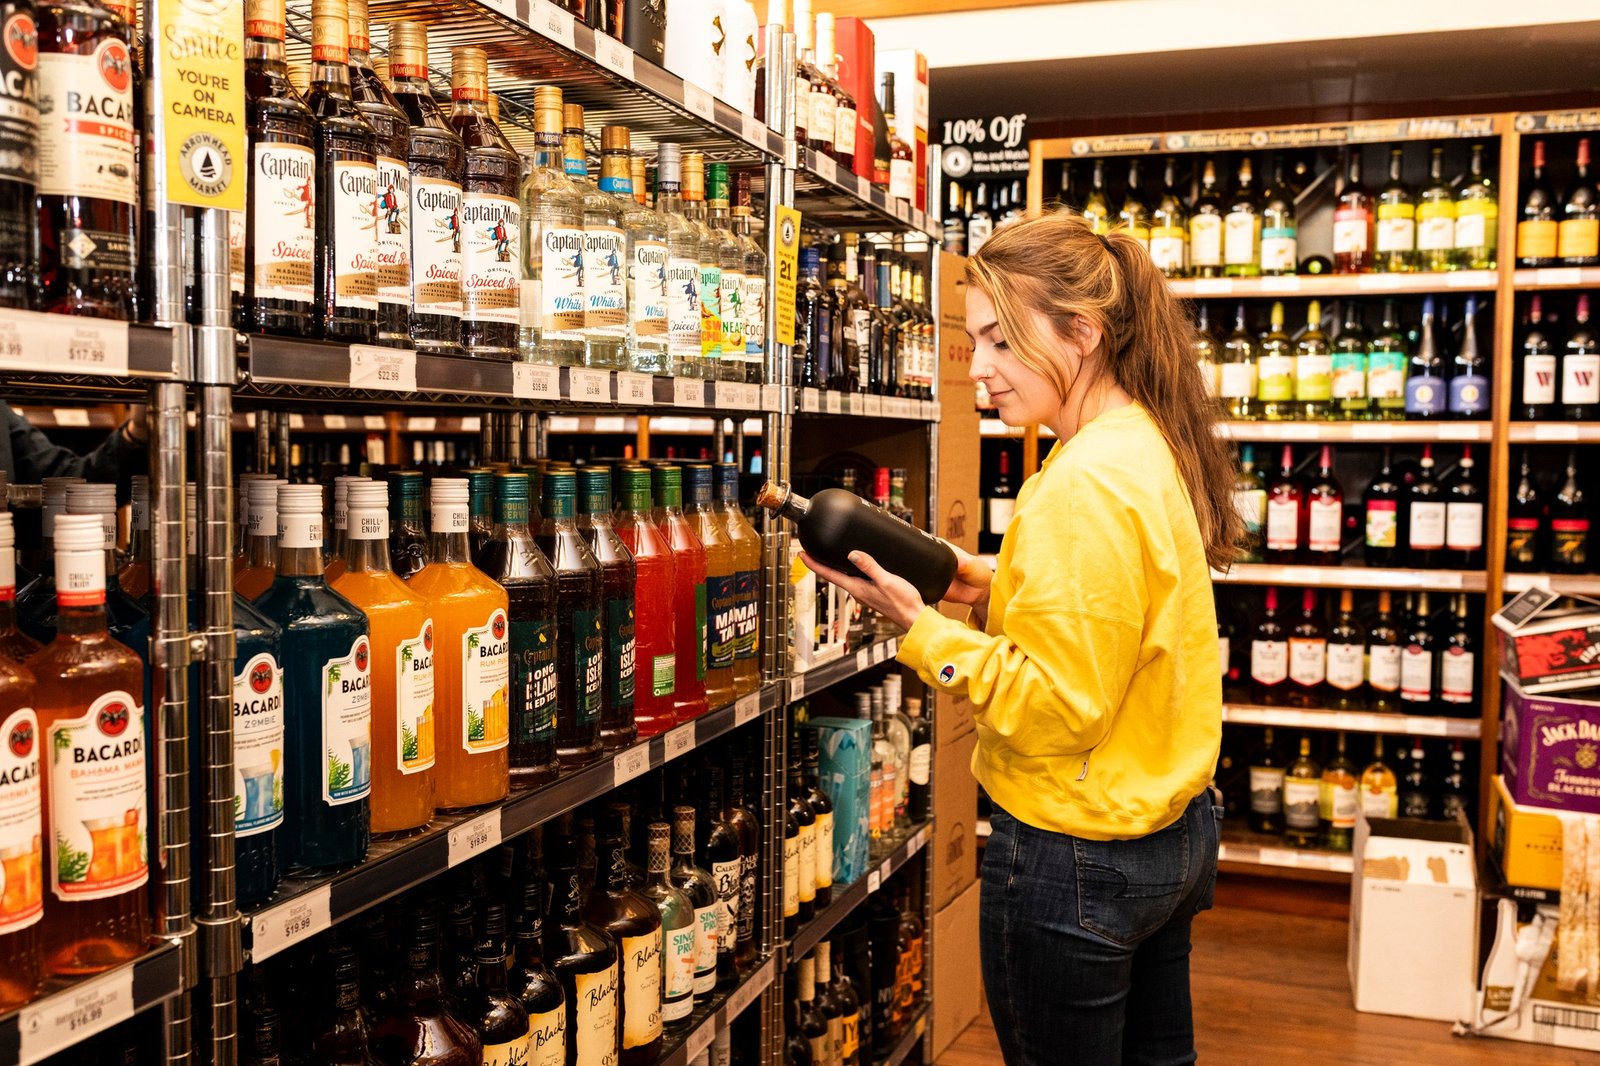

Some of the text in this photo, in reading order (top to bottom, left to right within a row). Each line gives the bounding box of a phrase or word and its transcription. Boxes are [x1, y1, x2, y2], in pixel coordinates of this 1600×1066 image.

[165, 24, 239, 61] Smile
[177, 68, 230, 91] YOU'RE
[193, 89, 215, 104] ON
[172, 102, 236, 125] CAMERA
[943, 113, 1027, 148] 10% Off
[180, 134, 232, 166] ARROWHEAD
[260, 153, 308, 179] Captain
[190, 177, 227, 195] MARKET
[416, 187, 457, 211] Captain
[546, 232, 580, 252] Captain
[425, 264, 459, 280] Spiced
[780, 260, 791, 281] 21
[466, 273, 506, 289] Spiced
[555, 297, 581, 310] White
[590, 295, 616, 308] White
[69, 348, 105, 362] $17.99
[378, 371, 399, 381] $22.99
[361, 518, 380, 526] CHILL
[69, 581, 90, 589] ENJOY
[735, 601, 757, 622] MAI
[738, 617, 755, 635] TAI
[480, 659, 496, 668] RUM
[245, 716, 276, 729] ZOMBIE
[1541, 723, 1578, 747] JACK
[70, 765, 120, 779] BAHAMA
[471, 834, 487, 849] $19.99
[285, 918, 311, 937] $19.99
